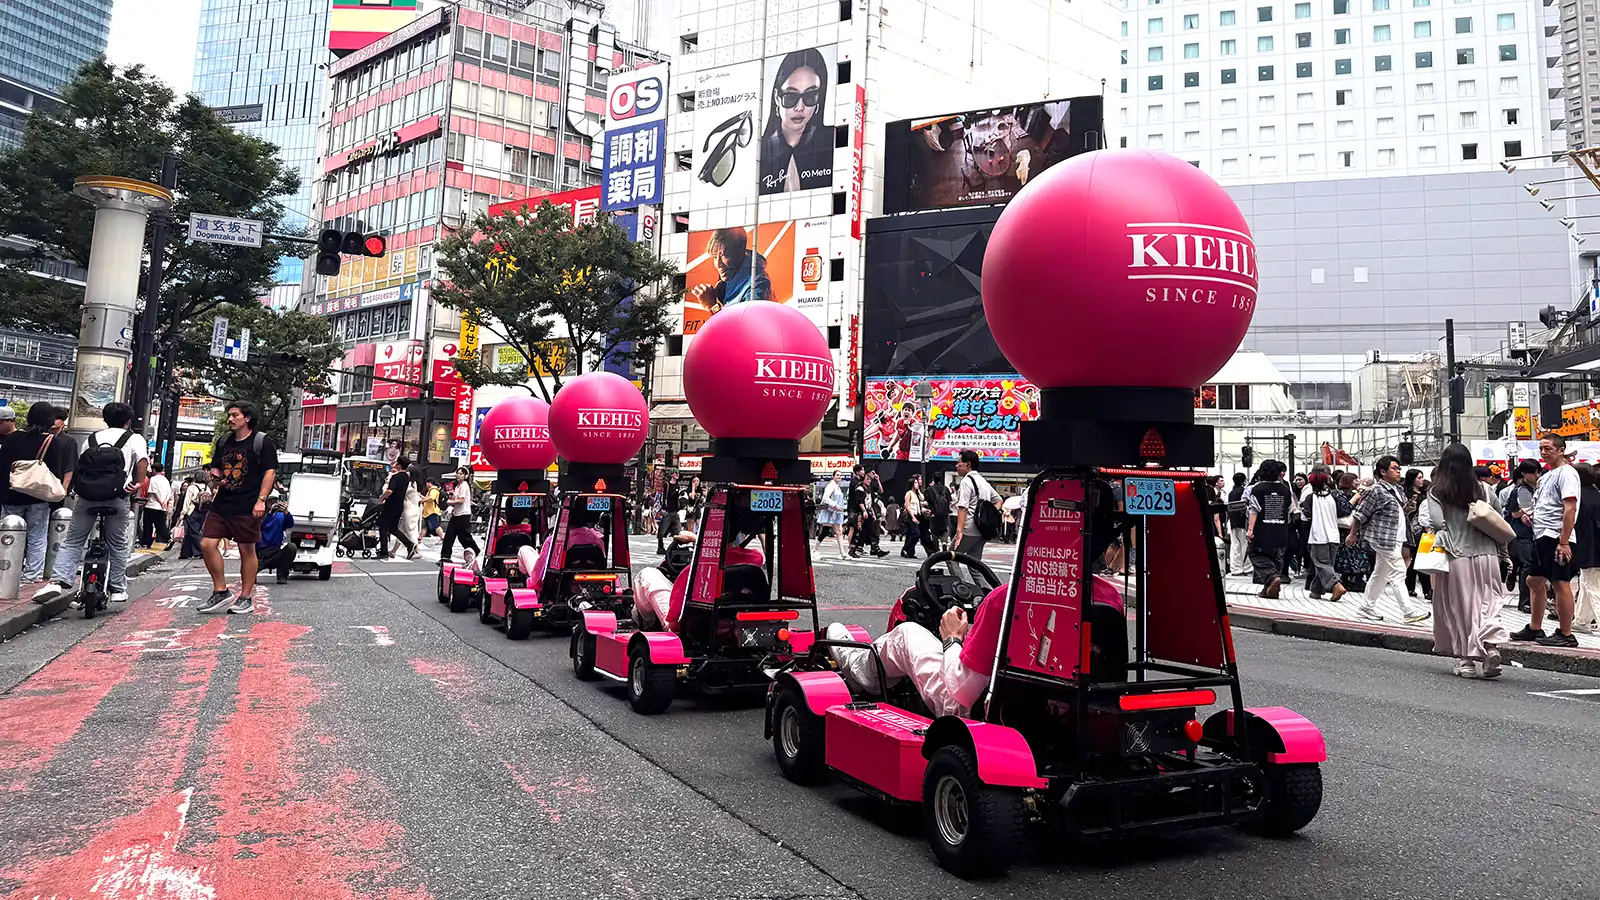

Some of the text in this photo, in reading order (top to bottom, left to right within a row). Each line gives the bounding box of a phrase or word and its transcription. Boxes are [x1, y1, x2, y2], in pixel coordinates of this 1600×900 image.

[611, 78, 660, 116] OS
[374, 131, 399, 156] ガスト
[609, 126, 658, 169] 調剤
[811, 168, 832, 178] Meta
[607, 165, 656, 205] 薬局
[195, 218, 257, 235] 道玄坂下
[195, 230, 255, 243] Dogenzaka shita
[797, 296, 824, 304] HUAWEI
[1146, 287, 1254, 314] SINCE 1851
[684, 320, 701, 332] FIT
[754, 358, 834, 386] KIEHL'S
[389, 385, 399, 396] 3F
[763, 388, 828, 402] SINCE 1851
[952, 387, 1002, 399] アジア大会
[456, 384, 472, 439] スギ薬局
[953, 399, 998, 415] 推せる
[577, 411, 642, 428] KIEHL'S
[494, 427, 550, 441] KIEHL'S
[583, 431, 612, 439] SINCE
[591, 501, 609, 510] 2030
[758, 497, 782, 509] 2002
[1136, 491, 1173, 511] 2029
[1039, 504, 1081, 520] KIEHLS
[1026, 545, 1079, 561] @KIEHLSJPと
[1026, 560, 1079, 578] SNS投稿で
[1025, 576, 1078, 598] 商品当たる
